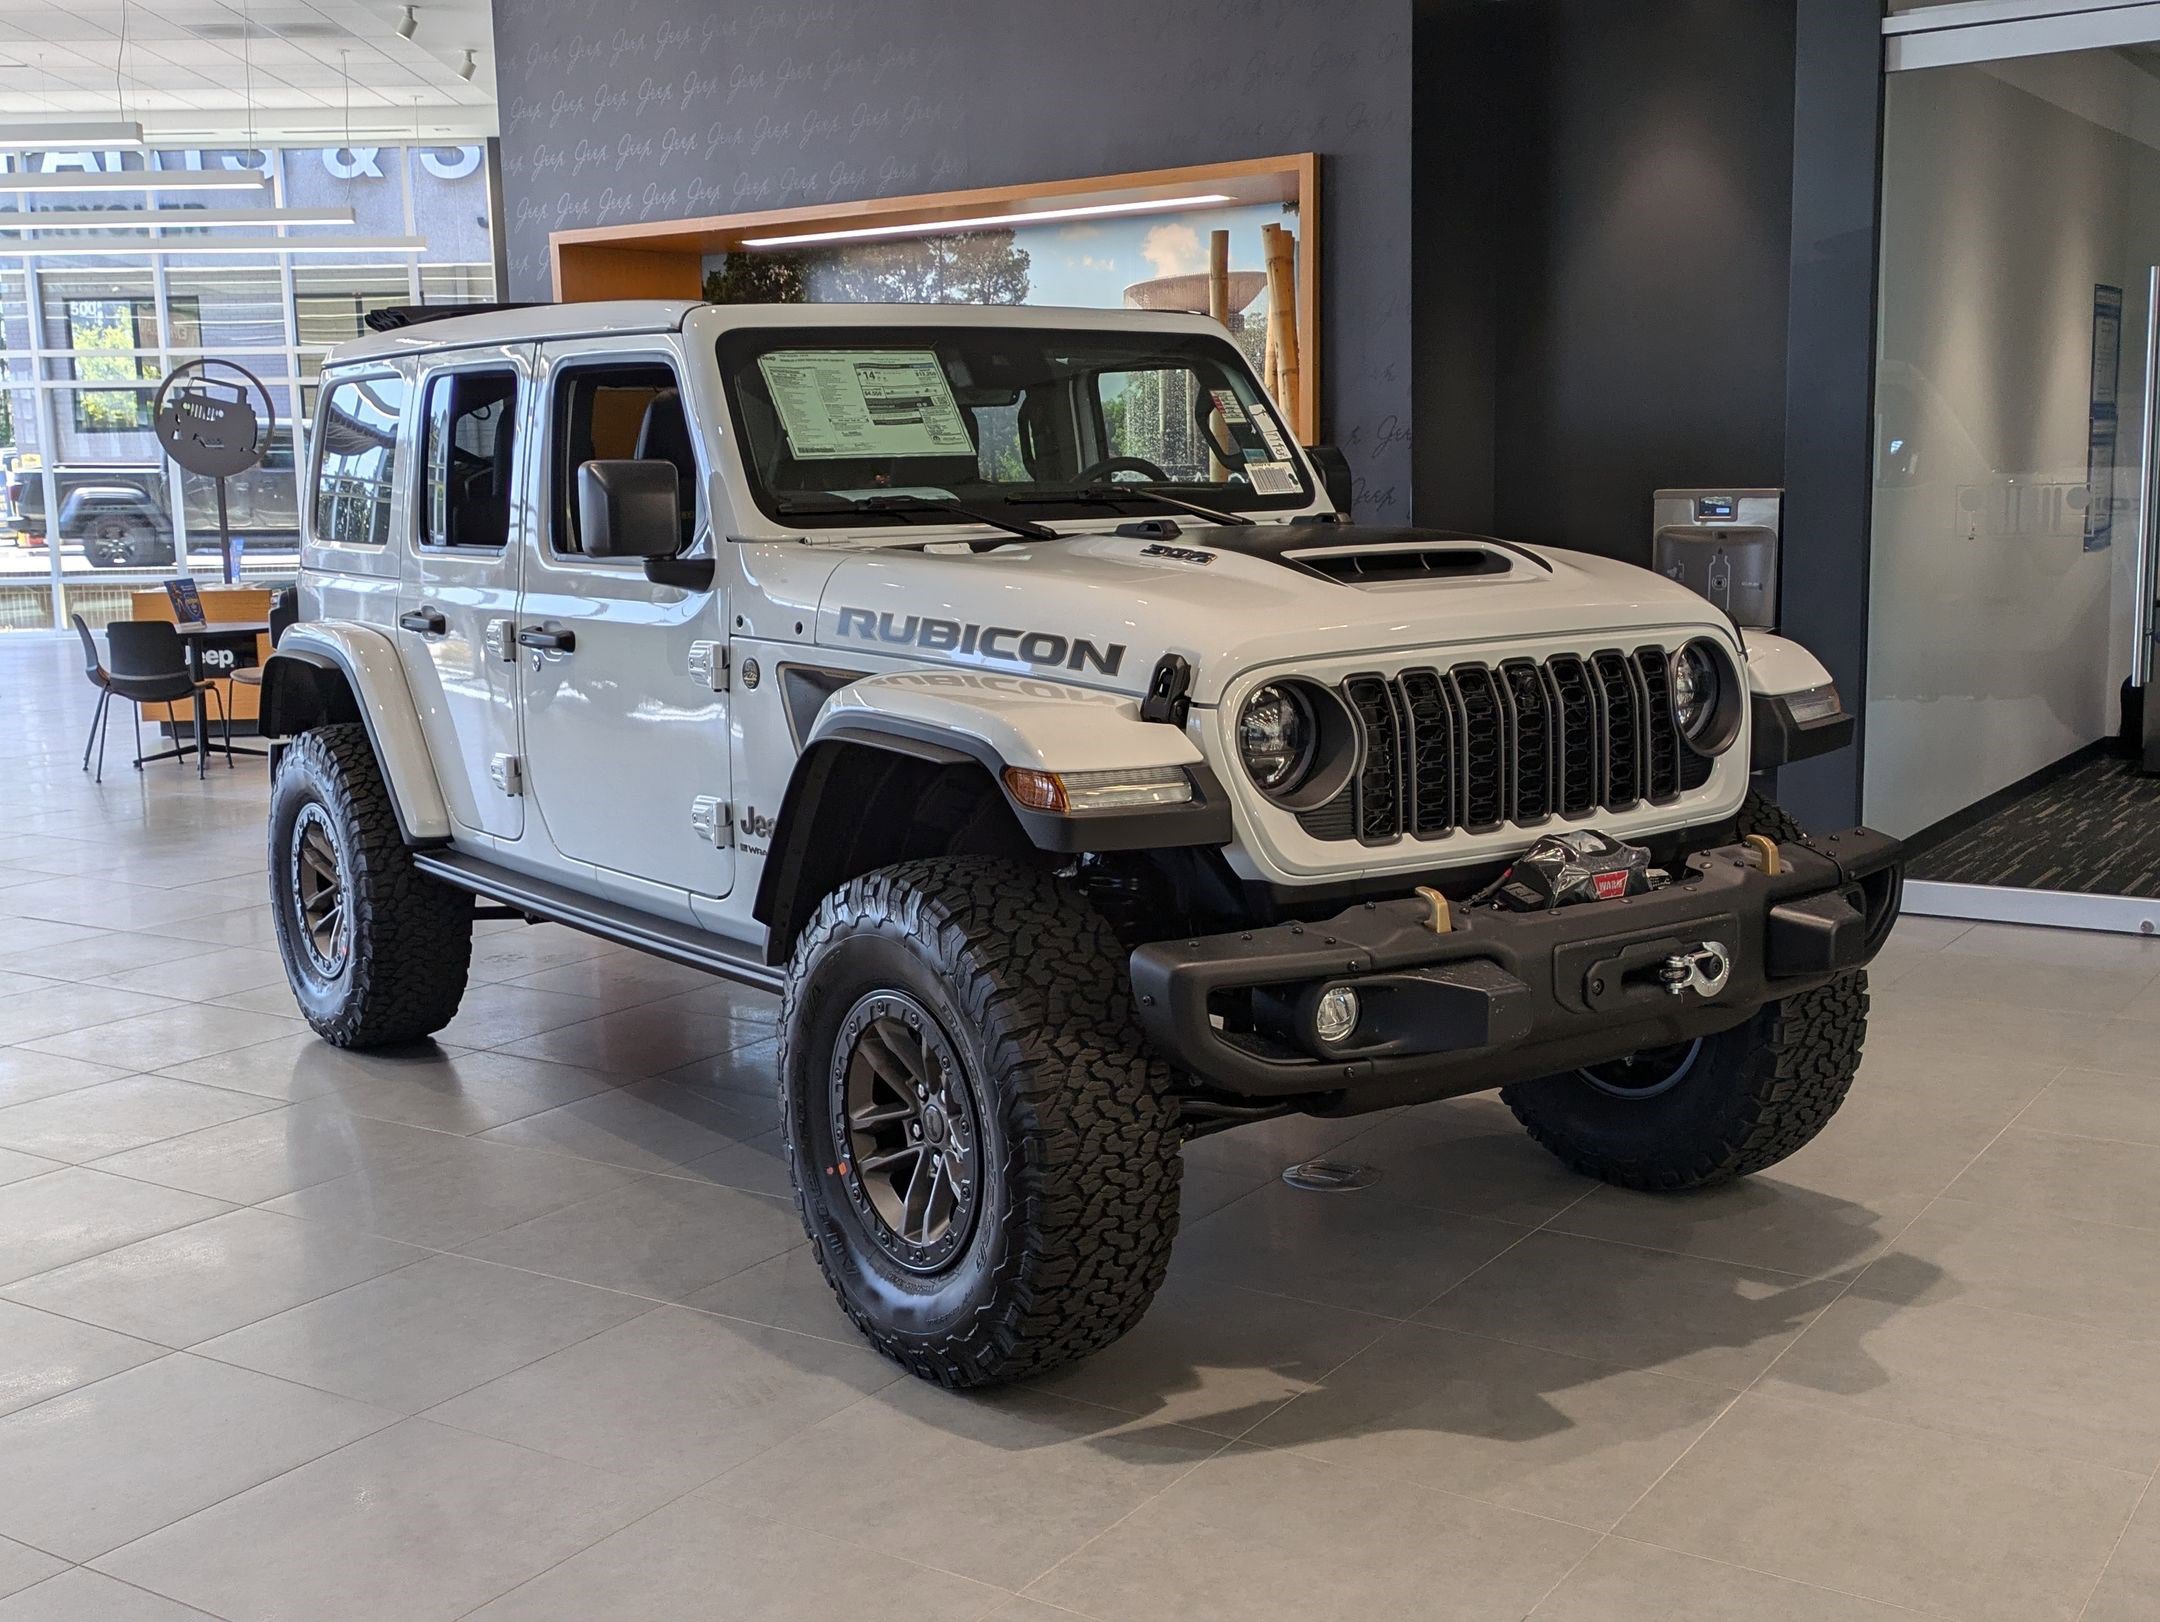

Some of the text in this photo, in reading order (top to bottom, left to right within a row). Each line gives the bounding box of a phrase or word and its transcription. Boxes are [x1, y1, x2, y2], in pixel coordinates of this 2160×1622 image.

[566, 35, 602, 75] Jeep
[609, 28, 647, 68] Jeep
[654, 20, 692, 61] Jeep
[508, 96, 543, 135] Jeep
[550, 90, 585, 128] Jeep
[592, 84, 629, 122] Jeep
[636, 77, 673, 117] Jeep
[680, 70, 718, 110] Jeep
[727, 64, 767, 104] Jeep
[774, 56, 814, 99] Jeep
[501, 149, 524, 177] eep
[531, 144, 565, 182] Jeep
[572, 139, 609, 176] Jeep
[615, 133, 652, 172] Jeep
[660, 127, 698, 167] Jeep
[705, 122, 744, 160] Jeep
[751, 115, 790, 155] Jeep
[799, 110, 841, 150] Jeep
[849, 103, 892, 144] Jeep
[514, 197, 549, 234] Jeep
[554, 192, 590, 229] Jeep
[597, 187, 632, 225] Jeep
[640, 183, 678, 220] Jeep
[684, 177, 721, 216] Jeep
[730, 172, 770, 211] Jeep
[777, 167, 817, 206] Jeep
[826, 161, 869, 201] Jeep
[506, 249, 529, 277] eep
[863, 371, 876, 380] 14
[185, 646, 233, 667] Jep
[836, 606, 1127, 677] RUBICON
[740, 806, 777, 839] Jee
[1599, 880, 1623, 891] WARN
